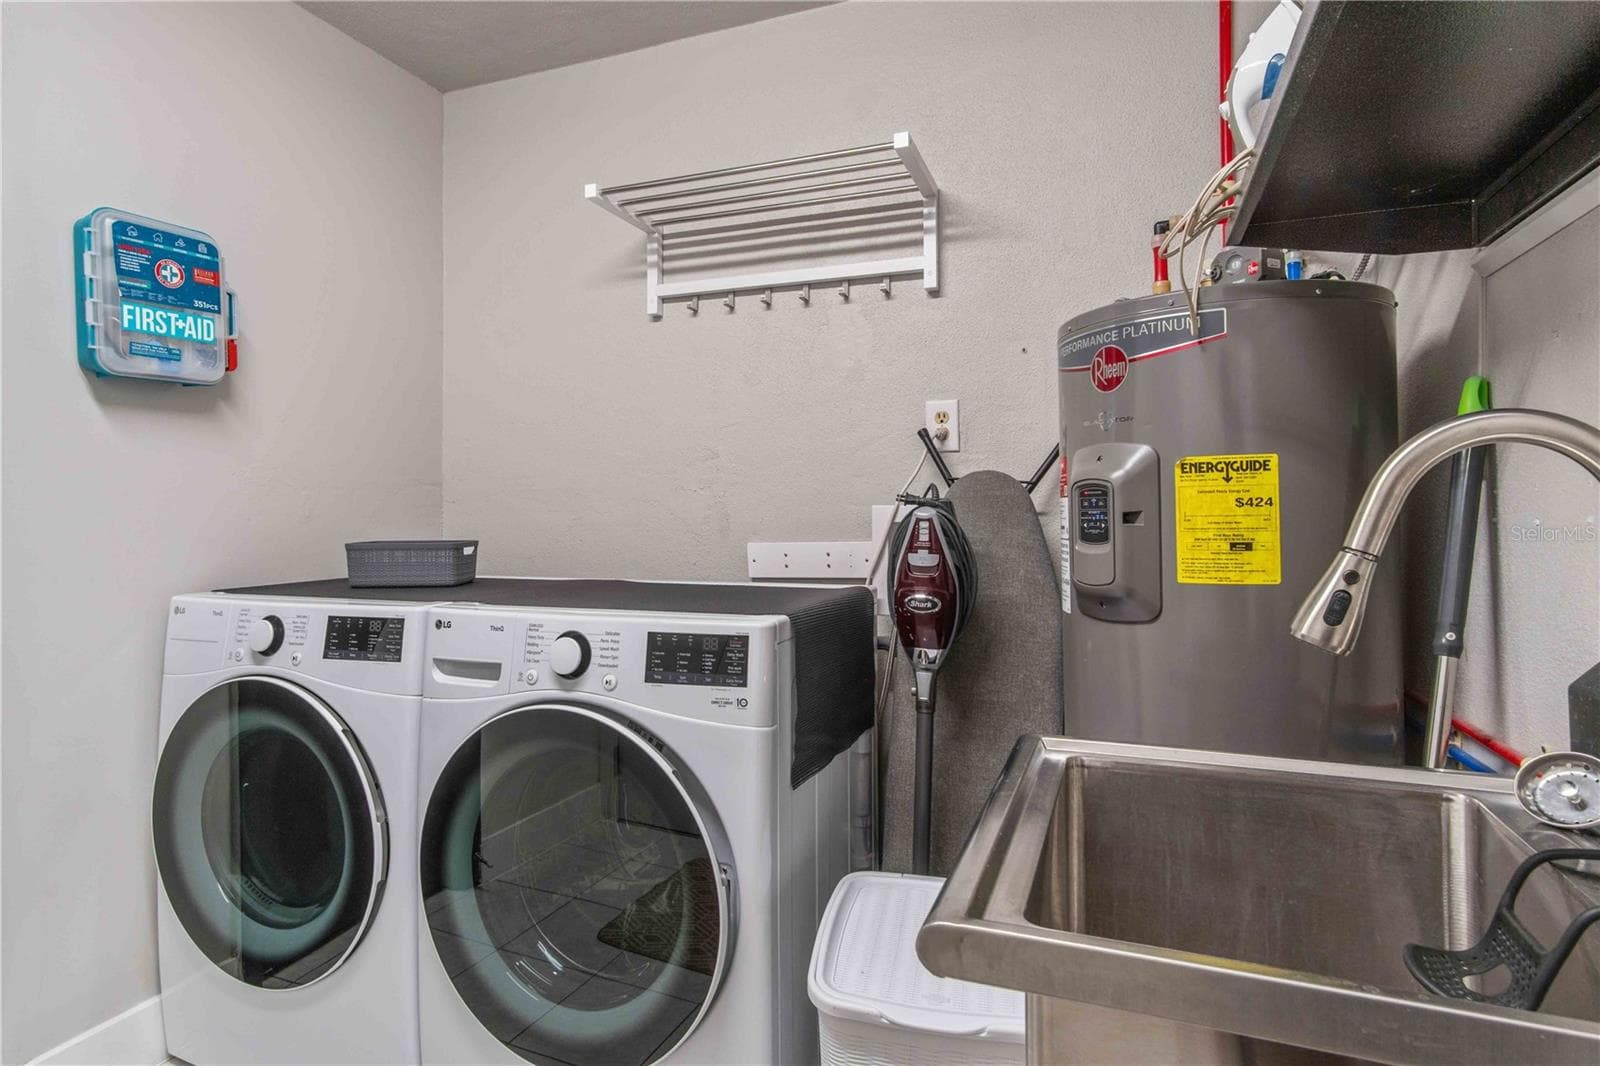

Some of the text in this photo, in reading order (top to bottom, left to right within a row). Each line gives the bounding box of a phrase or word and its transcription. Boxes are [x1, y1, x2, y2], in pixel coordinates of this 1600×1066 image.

[1094, 349, 1126, 386] Rheem
[1180, 459, 1272, 475] ENERGYGUIDE
[1235, 496, 1274, 508] $424
[909, 599, 932, 608] Shark
[442, 620, 452, 629] LG
